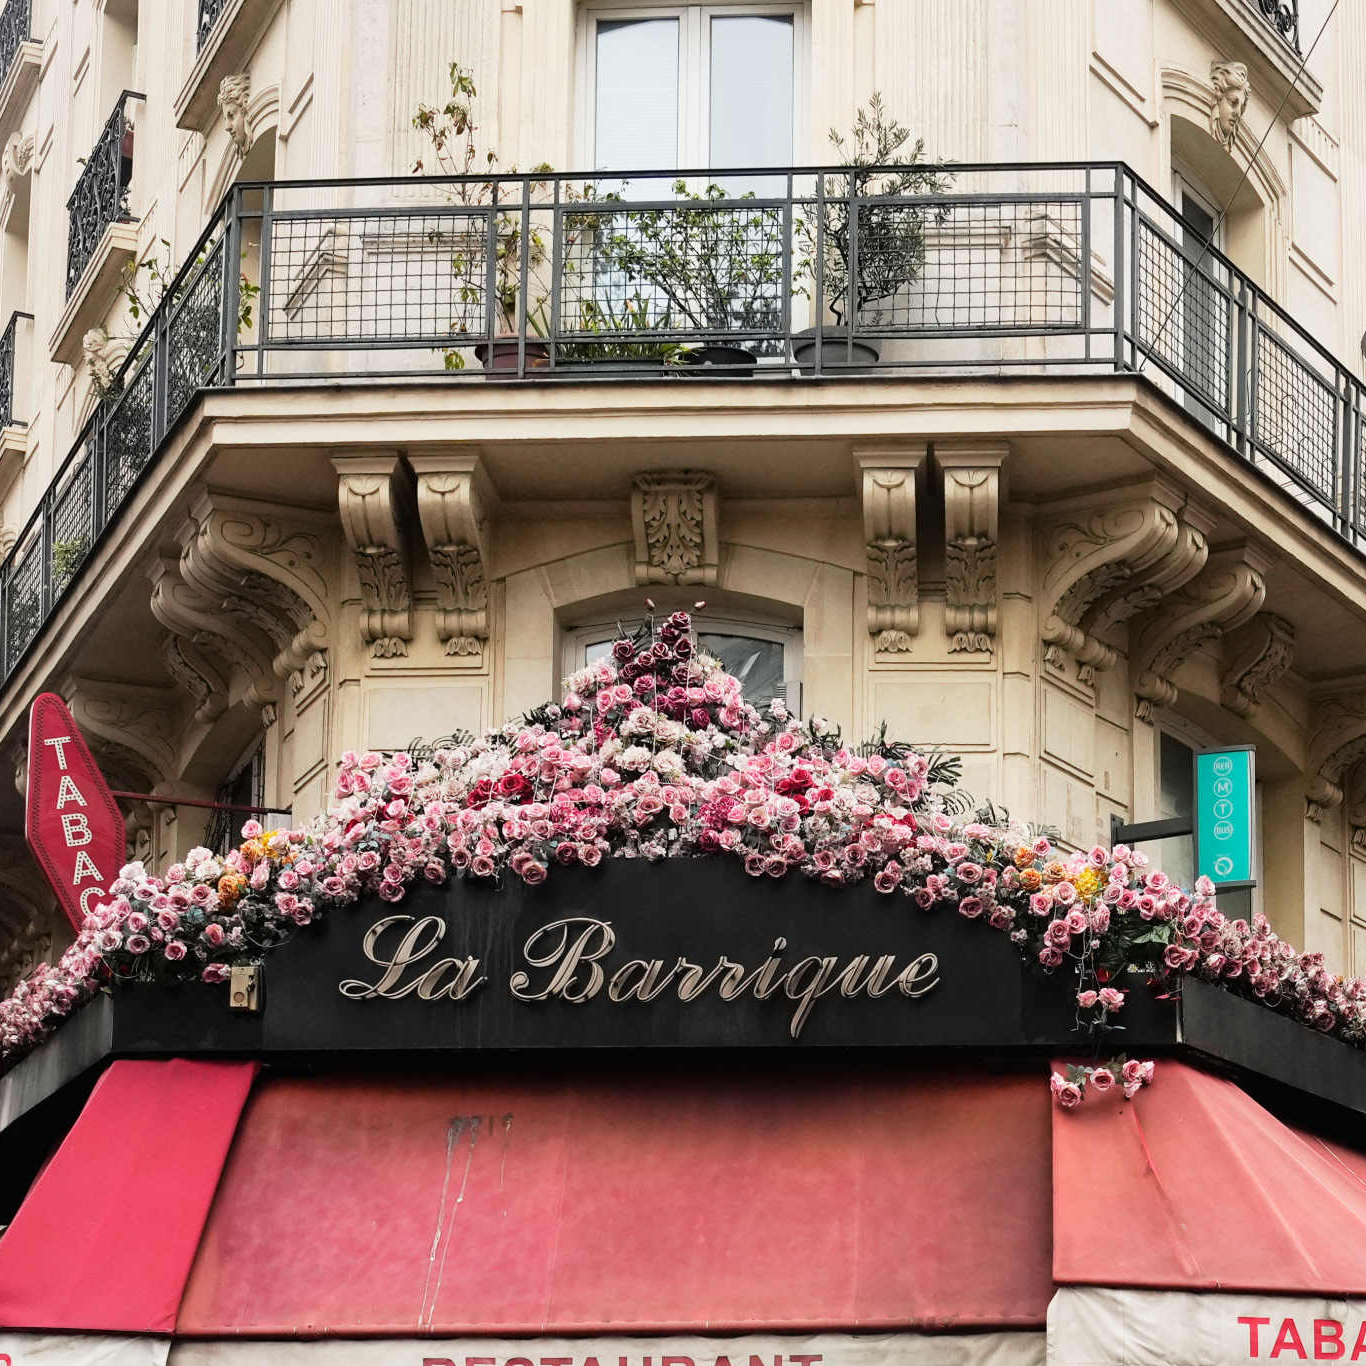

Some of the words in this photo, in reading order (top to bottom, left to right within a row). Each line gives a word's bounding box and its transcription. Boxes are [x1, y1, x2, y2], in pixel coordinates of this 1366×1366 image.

[44, 736, 106, 916] TABAC
[338, 915, 488, 1000] La
[510, 917, 941, 1039] Barrique
